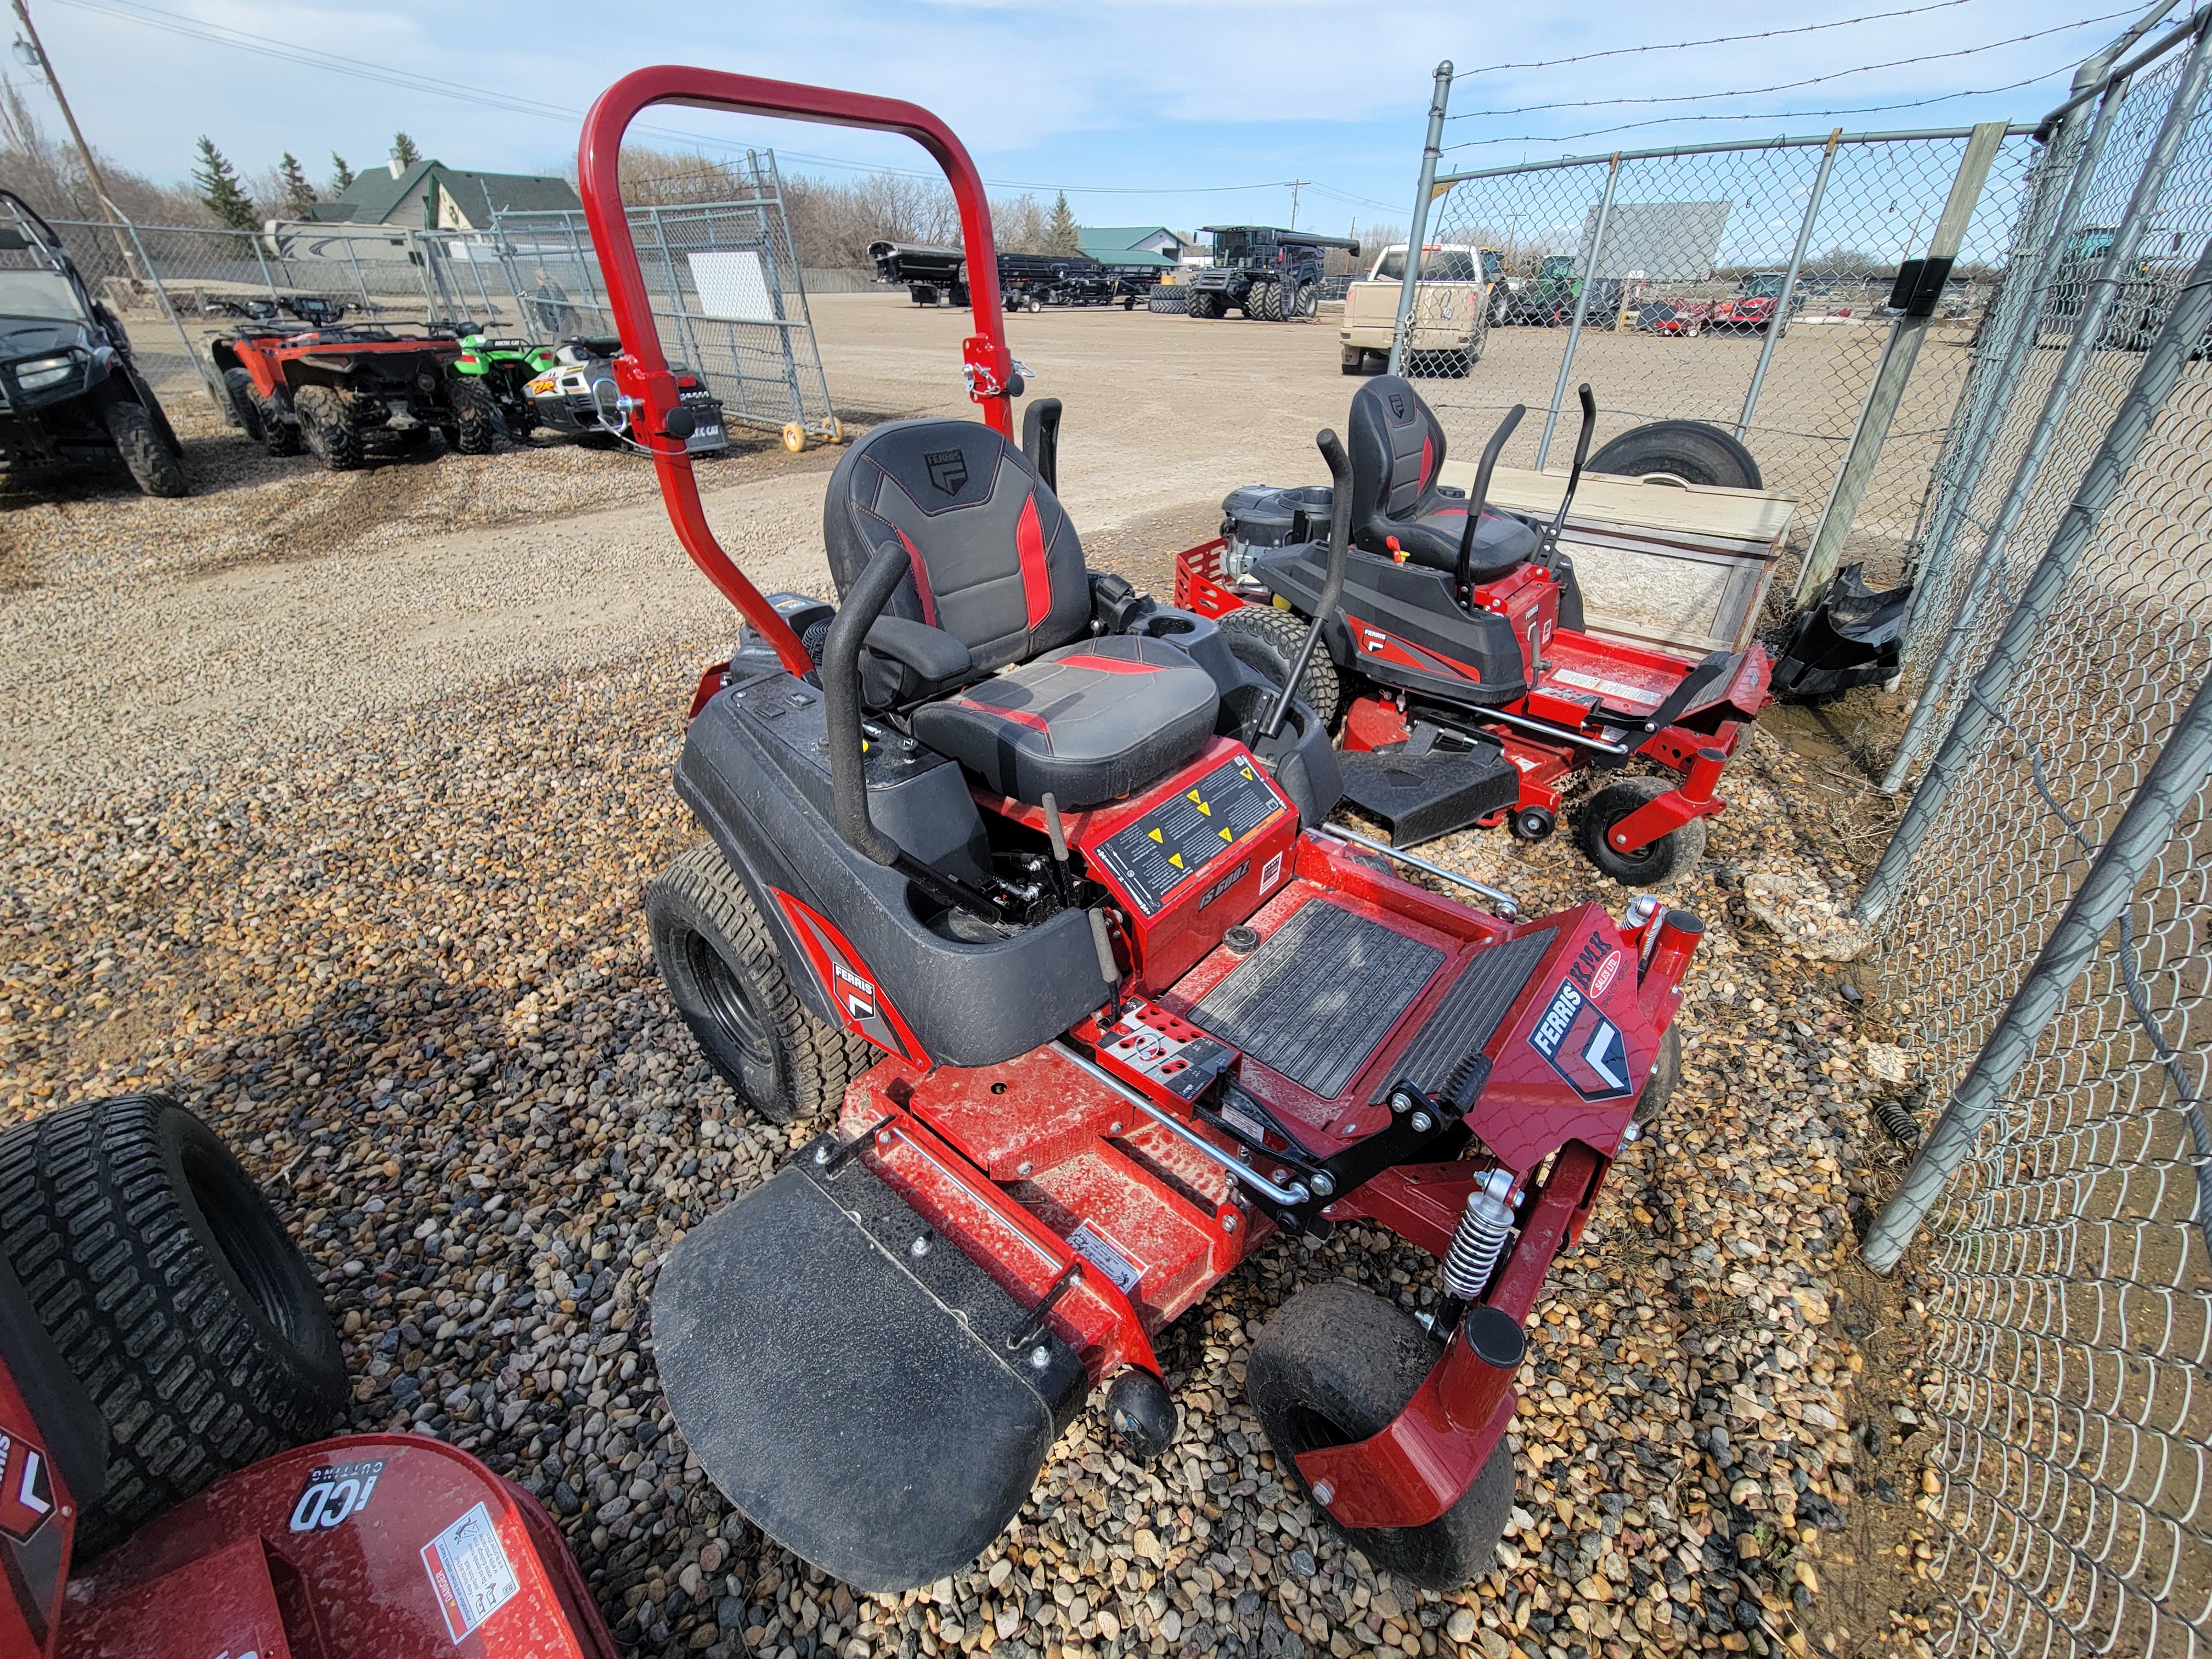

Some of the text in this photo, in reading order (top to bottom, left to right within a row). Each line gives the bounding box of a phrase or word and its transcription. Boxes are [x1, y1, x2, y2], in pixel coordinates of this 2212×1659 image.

[928, 449, 961, 465] FERRIS
[1364, 629, 1386, 640] FERRIS
[836, 964, 873, 996] FERRIS
[1595, 957, 1617, 991] SALES LTD.
[1534, 985, 1581, 1056] FERRIS
[312, 1462, 383, 1481] CUTTING
[438, 1544, 447, 1558] hazard
[444, 1558, 453, 1573] objects
[436, 1570, 452, 1602] DANGER
[450, 1572, 458, 1588] thrown
[459, 1596, 471, 1620] Amputation
